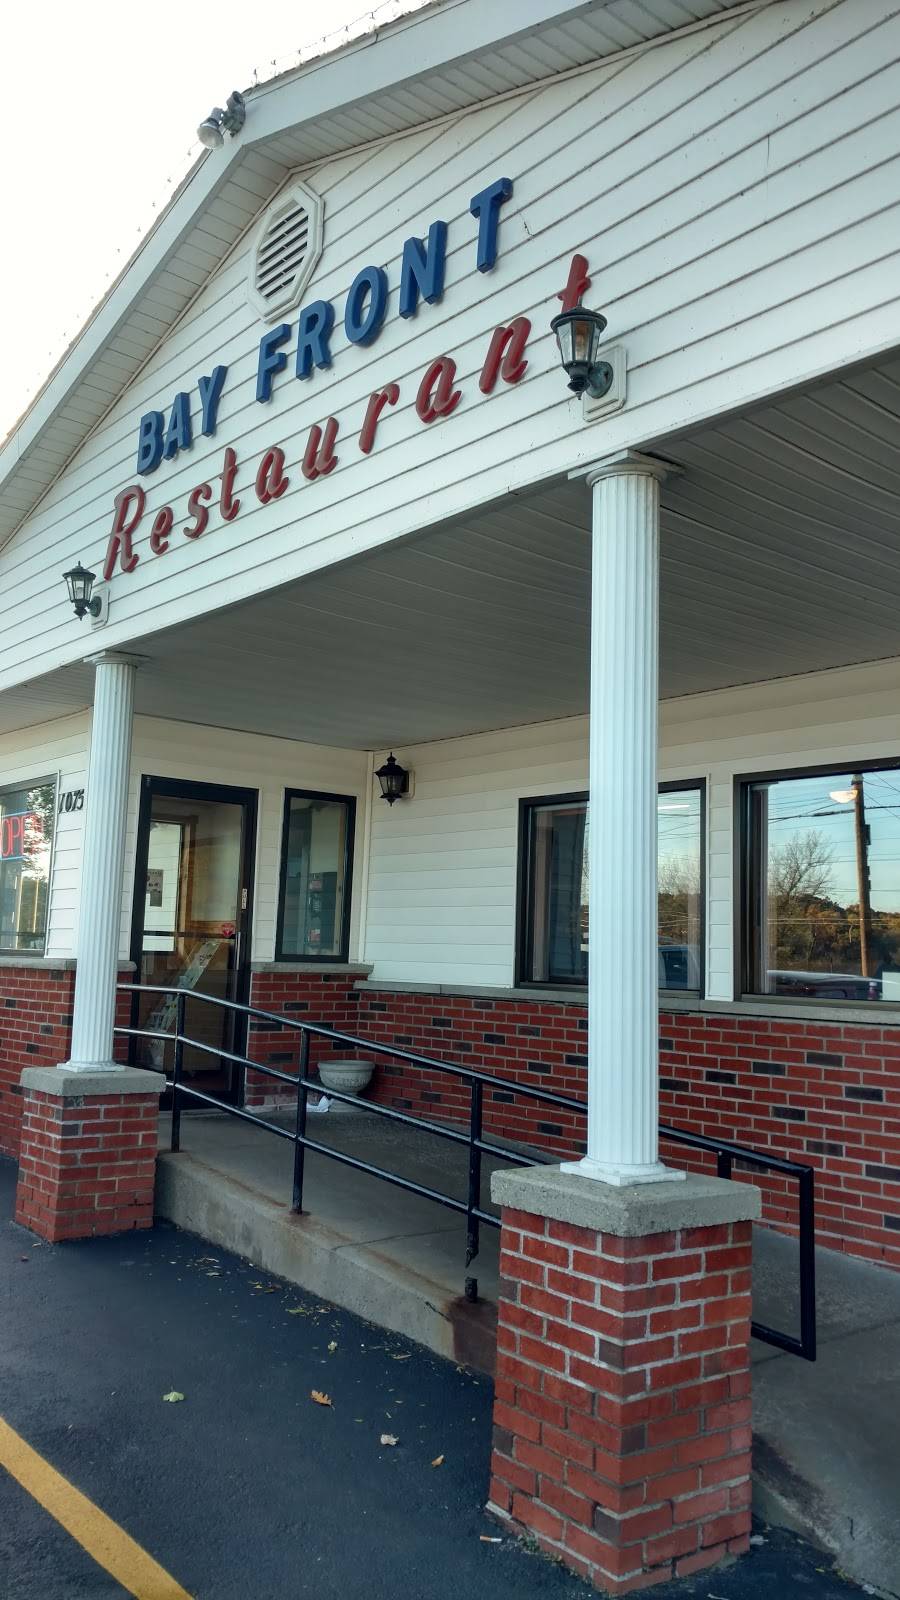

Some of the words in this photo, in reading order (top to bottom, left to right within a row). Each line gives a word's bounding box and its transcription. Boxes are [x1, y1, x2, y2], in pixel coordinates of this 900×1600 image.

[103, 254, 591, 581] Restaurant
[137, 365, 228, 476] BAY
[256, 177, 513, 403] FRONT
[59, 789, 84, 814] 1075
